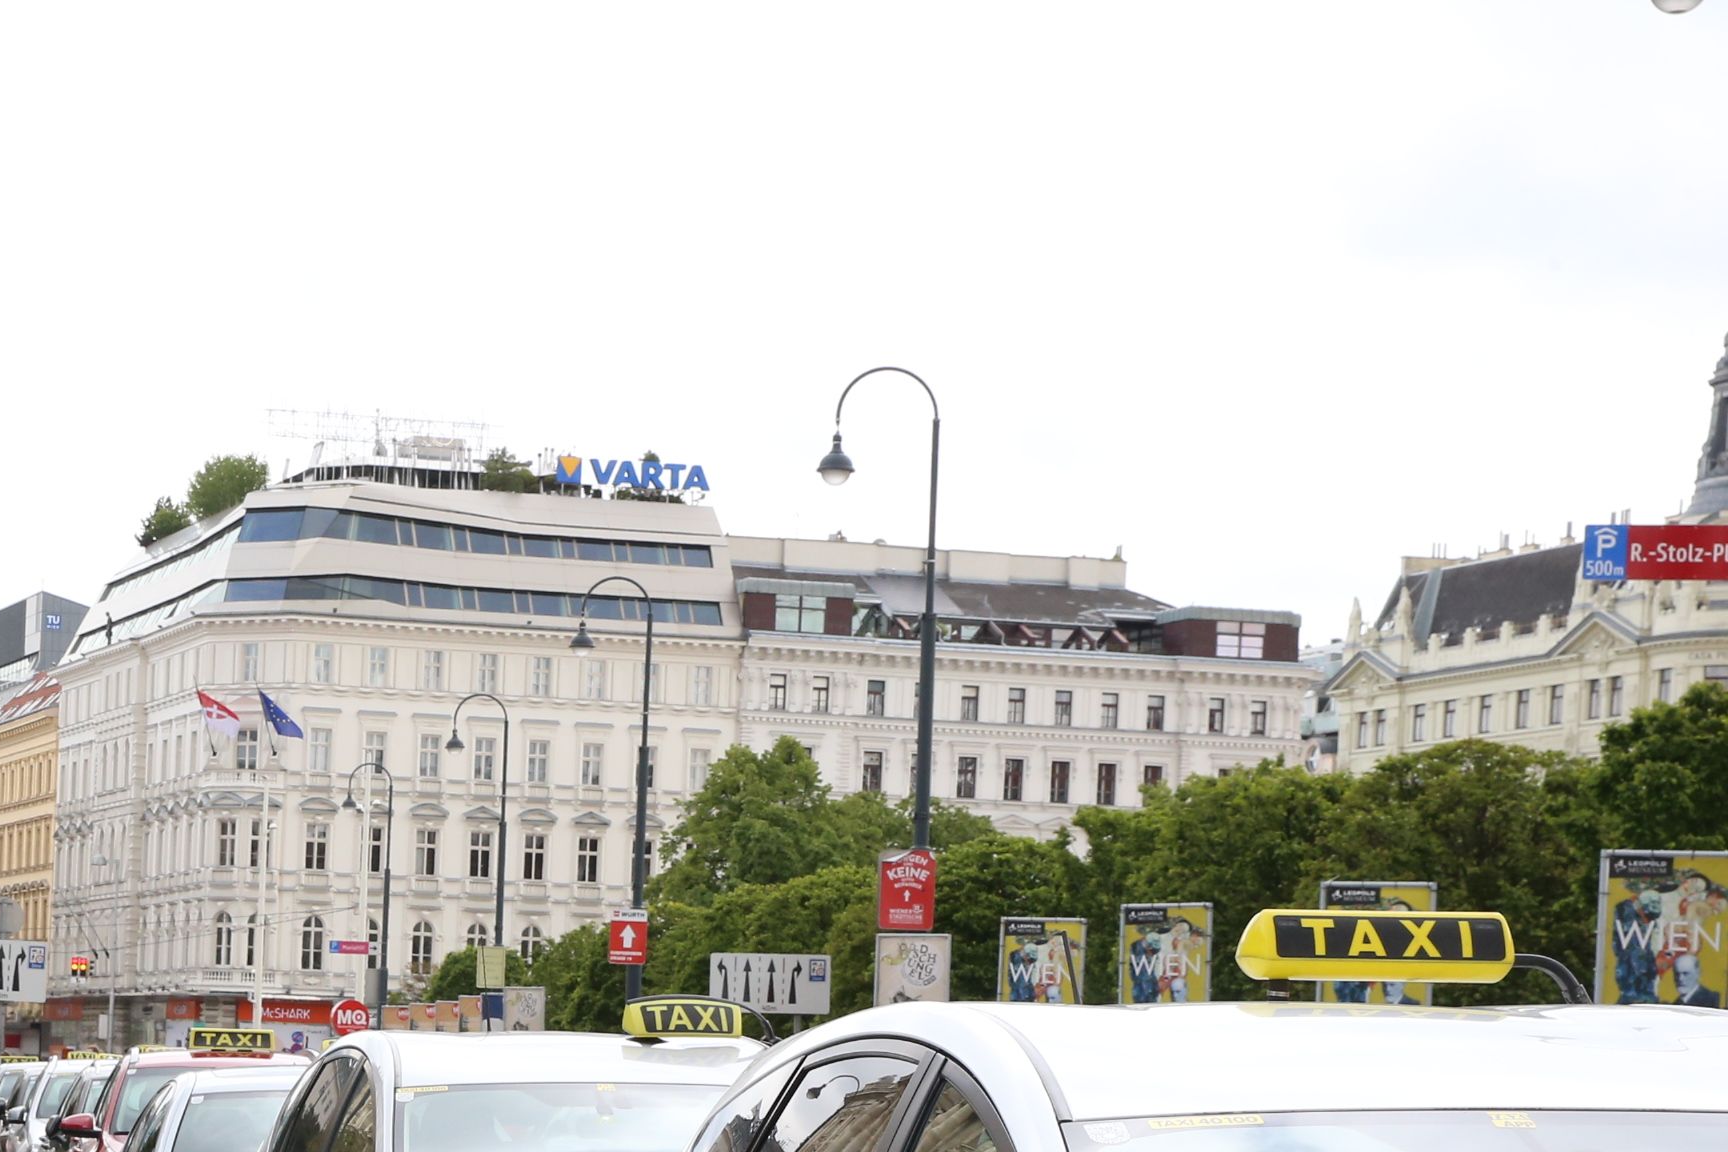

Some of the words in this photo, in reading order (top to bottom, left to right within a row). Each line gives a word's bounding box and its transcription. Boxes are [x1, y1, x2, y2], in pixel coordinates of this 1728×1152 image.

[590, 458, 710, 491] VARTA
[1597, 534, 1616, 558] P
[46, 615, 60, 625] TU
[886, 866, 930, 882] KEINE
[1301, 918, 1474, 959] TAXI
[1615, 919, 1721, 952] WIEN
[1130, 953, 1201, 977] WIEN
[262, 1007, 311, 1019] McSHARK
[337, 1009, 368, 1025] MQ
[646, 1005, 728, 1032] TAXI
[201, 1033, 262, 1047] TAXI
[1155, 1119, 1193, 1127] TAXI
